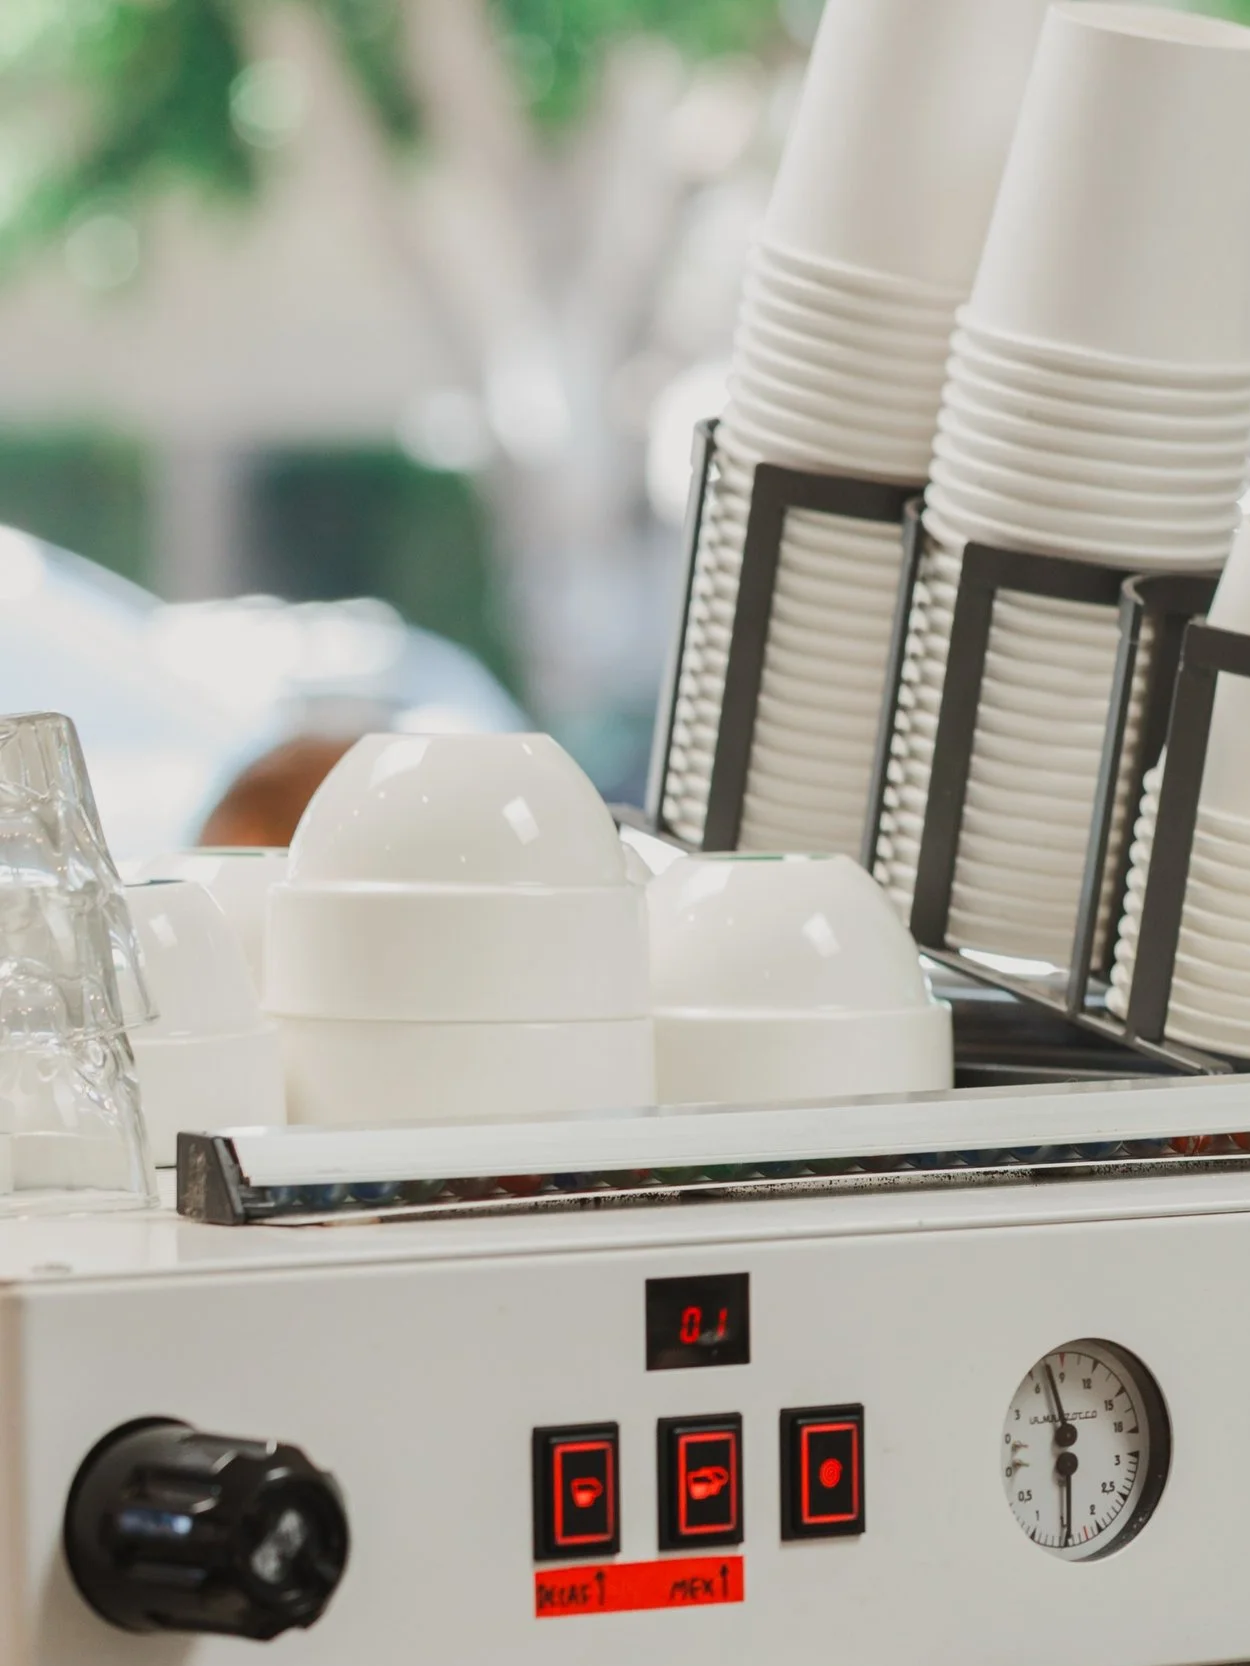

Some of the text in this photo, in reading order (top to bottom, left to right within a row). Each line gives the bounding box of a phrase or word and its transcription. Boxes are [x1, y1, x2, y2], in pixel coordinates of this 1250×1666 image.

[1059, 1372, 1065, 1384] 9
[1082, 1378, 1092, 1389] 12
[1035, 1383, 1041, 1394] 6
[1104, 1400, 1114, 1411] 15
[1015, 1409, 1020, 1420] 3
[1113, 1422, 1123, 1433] 18
[1005, 1434, 1011, 1444] 0
[1114, 1455, 1120, 1466] 3
[1006, 1467, 1012, 1478] 0
[1018, 1490, 1032, 1502] 0,5
[1090, 1505, 1096, 1515] 2
[669, 1578, 714, 1601] MEX
